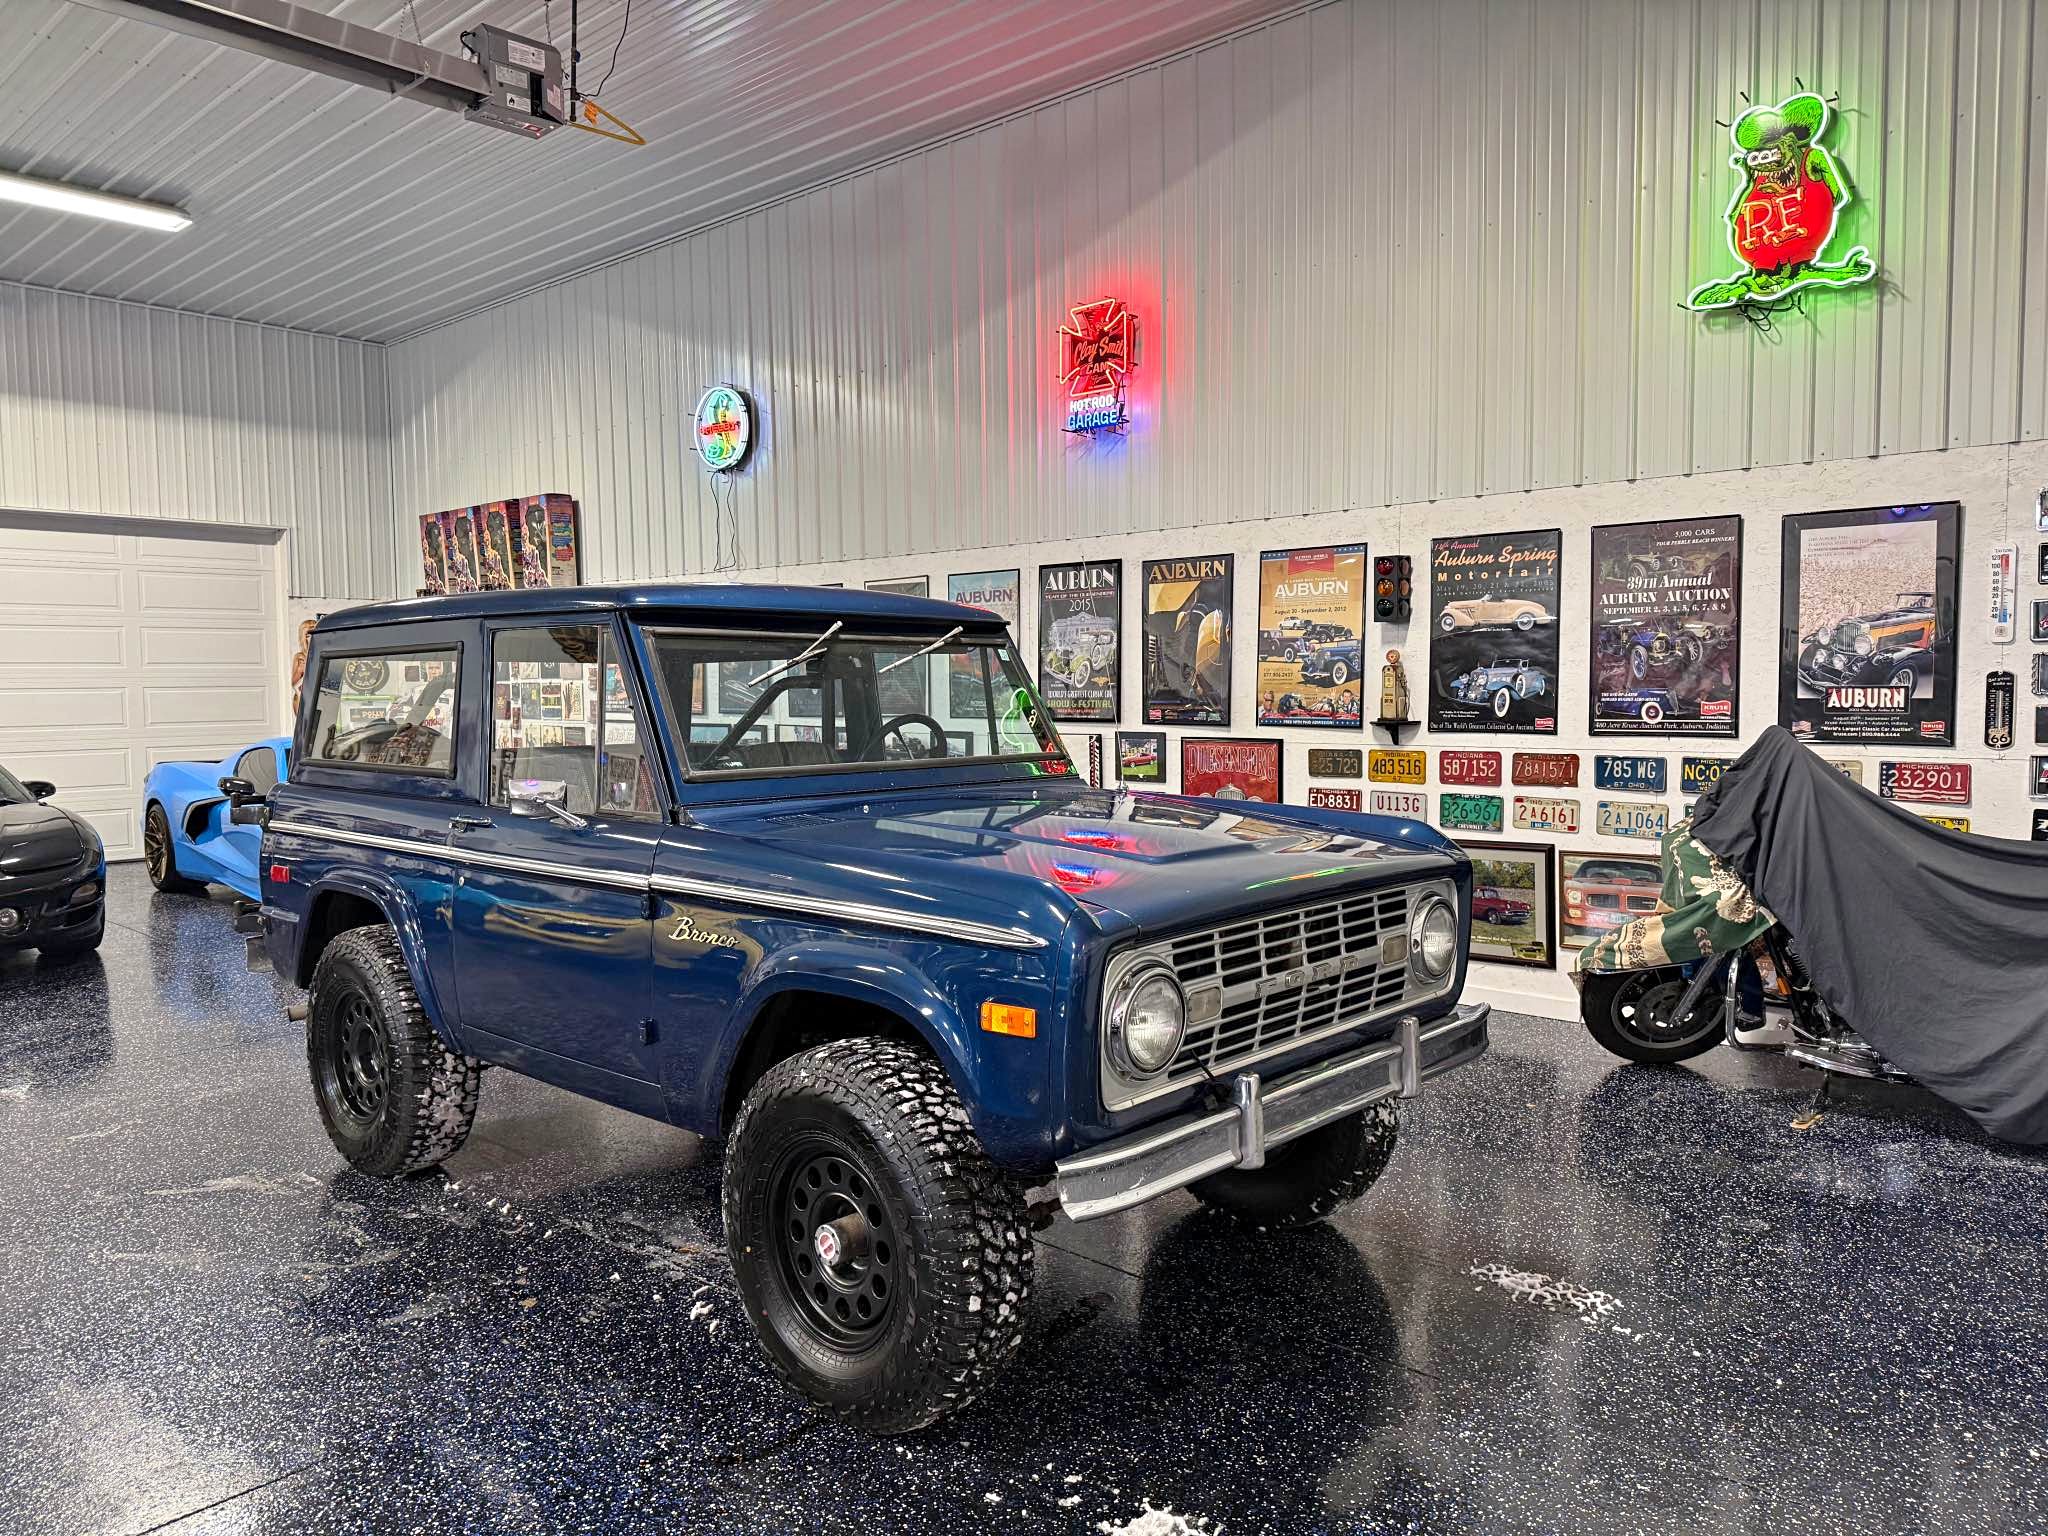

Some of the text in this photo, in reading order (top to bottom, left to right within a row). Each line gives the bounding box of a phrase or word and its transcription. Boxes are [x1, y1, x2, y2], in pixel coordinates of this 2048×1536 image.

[1073, 341, 1098, 366] Clay
[1068, 409, 1118, 429] GARAGE
[1695, 528, 1715, 536] CARS
[1434, 545, 1558, 568] Auburn Spring
[1045, 568, 1114, 590] AUBURN
[1149, 560, 1225, 581] AUBURN
[1274, 580, 1349, 598] AUBURN
[1660, 572, 1713, 588] Annual
[956, 589, 1012, 603] AUBURN
[1069, 599, 1091, 611] 2015
[1600, 588, 1733, 605] AUBURN AUCTION
[1603, 606, 1651, 615] SEPTEMBER
[1711, 603, 1719, 611] &
[1721, 602, 1726, 610] 8
[1078, 699, 1113, 708] FESTIVAL
[1827, 687, 1905, 708] AUBURN
[1990, 734, 2009, 744] 66
[1186, 743, 1277, 783] DUESENBERG
[1603, 760, 1657, 779] 785 WG
[1887, 769, 1963, 790] 232901
[1377, 795, 1420, 813] U113G
[668, 916, 740, 948] Bronco
